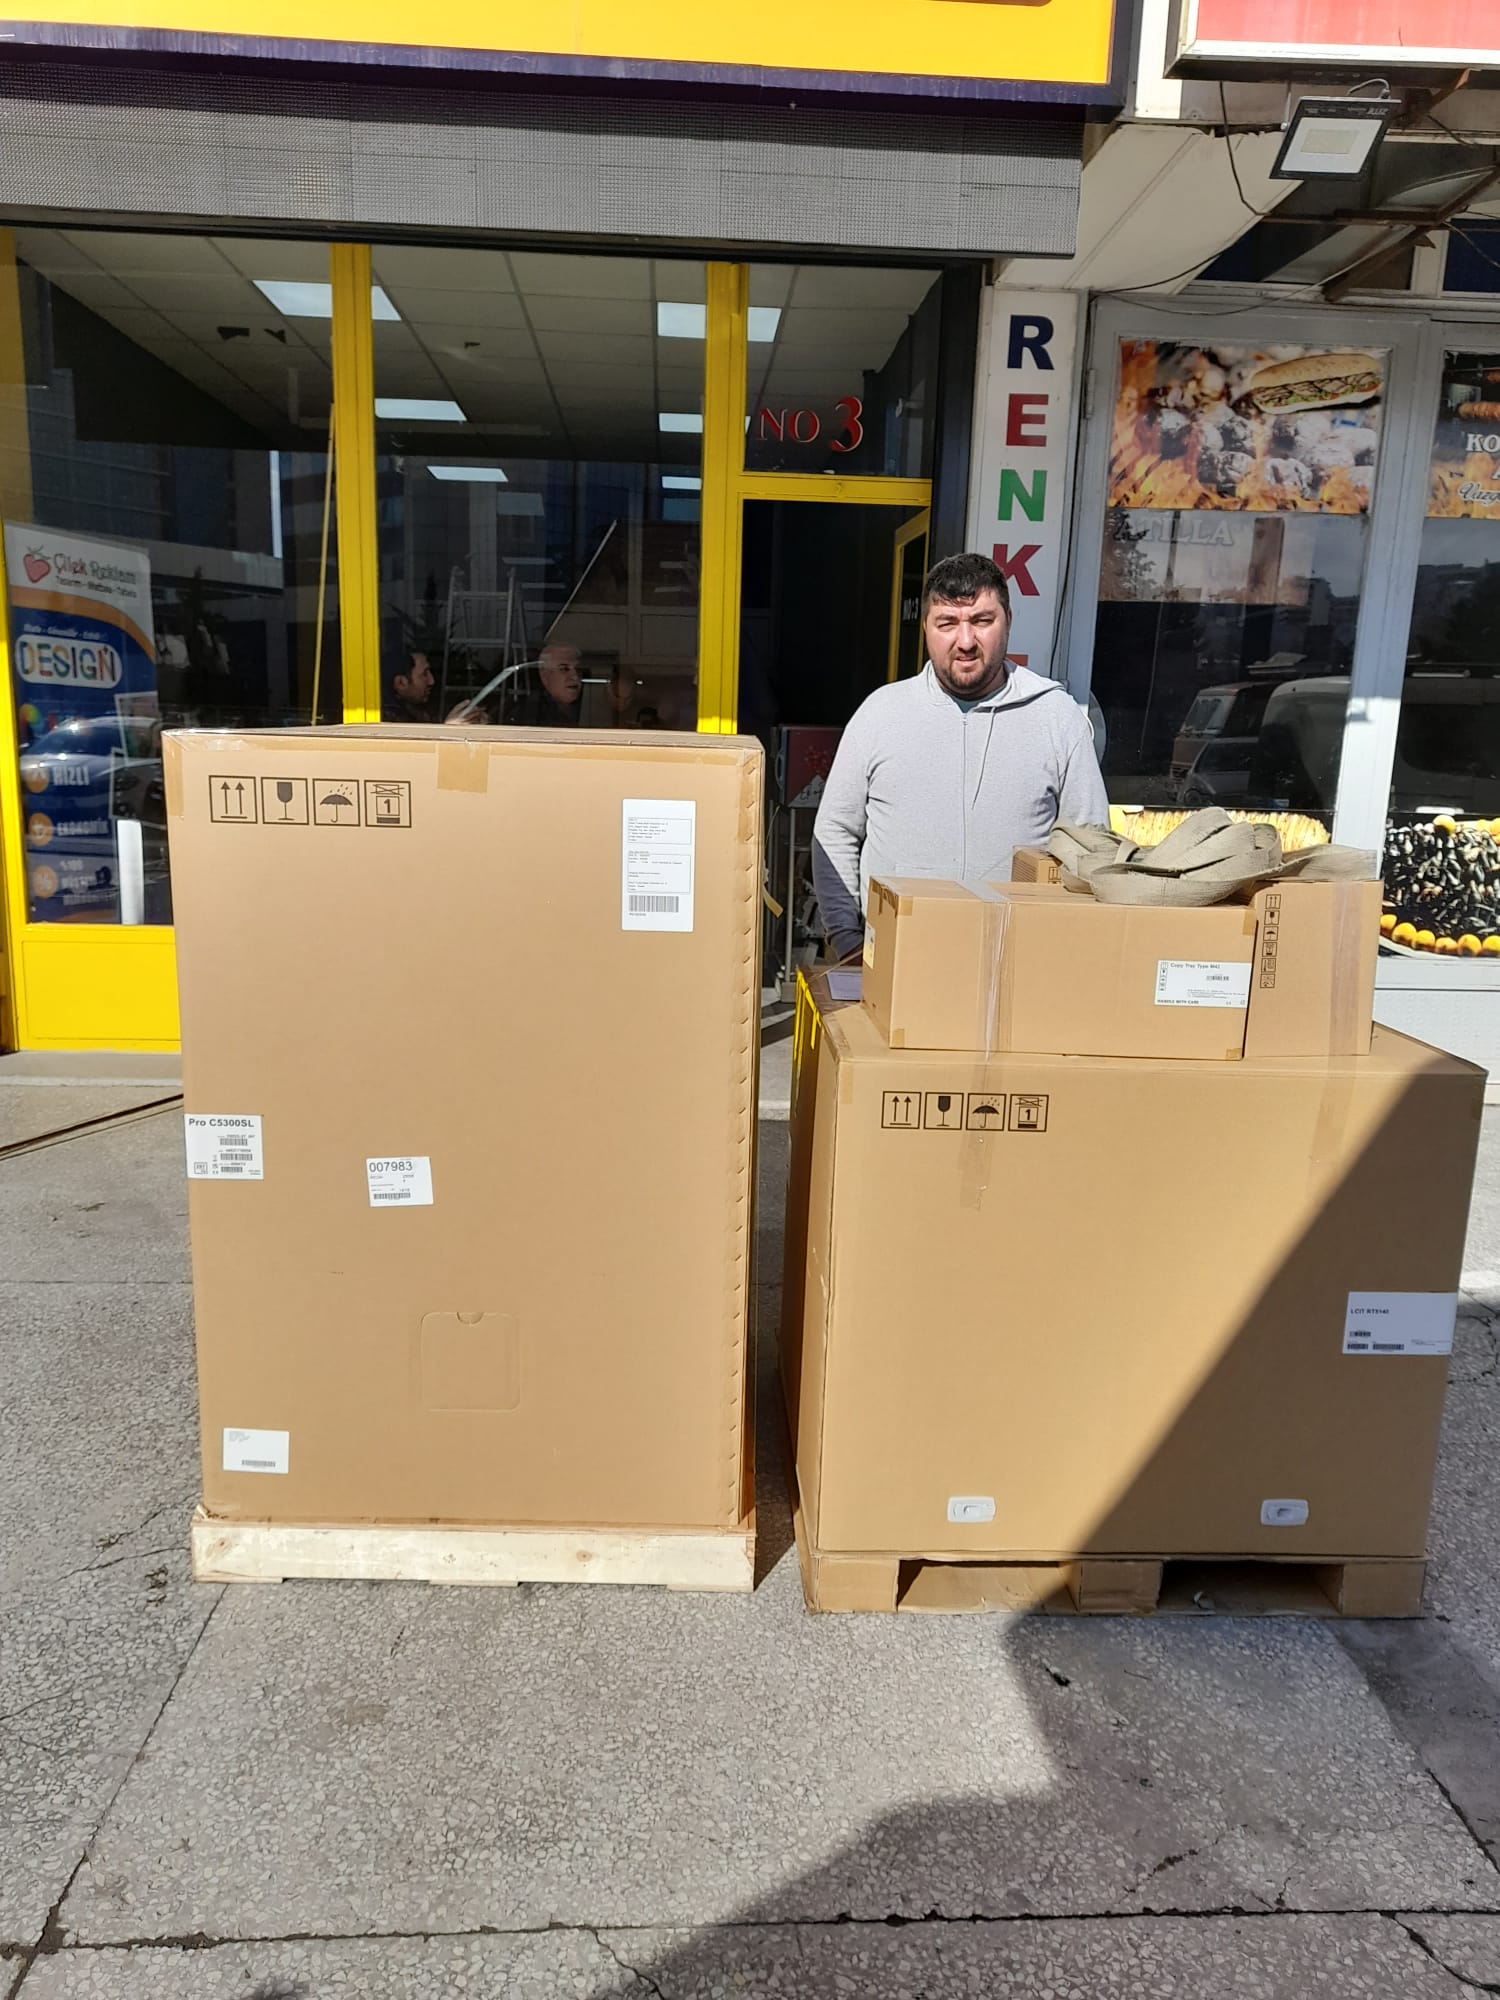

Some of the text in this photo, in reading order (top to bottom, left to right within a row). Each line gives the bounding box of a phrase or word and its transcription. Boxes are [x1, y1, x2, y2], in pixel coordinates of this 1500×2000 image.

[759, 395, 864, 452] NO 3
[993, 314, 1055, 668] RENK
[20, 641, 116, 682] DESIGN
[189, 1117, 255, 1128] Pro C5300SL
[369, 1160, 413, 1173] 007983
